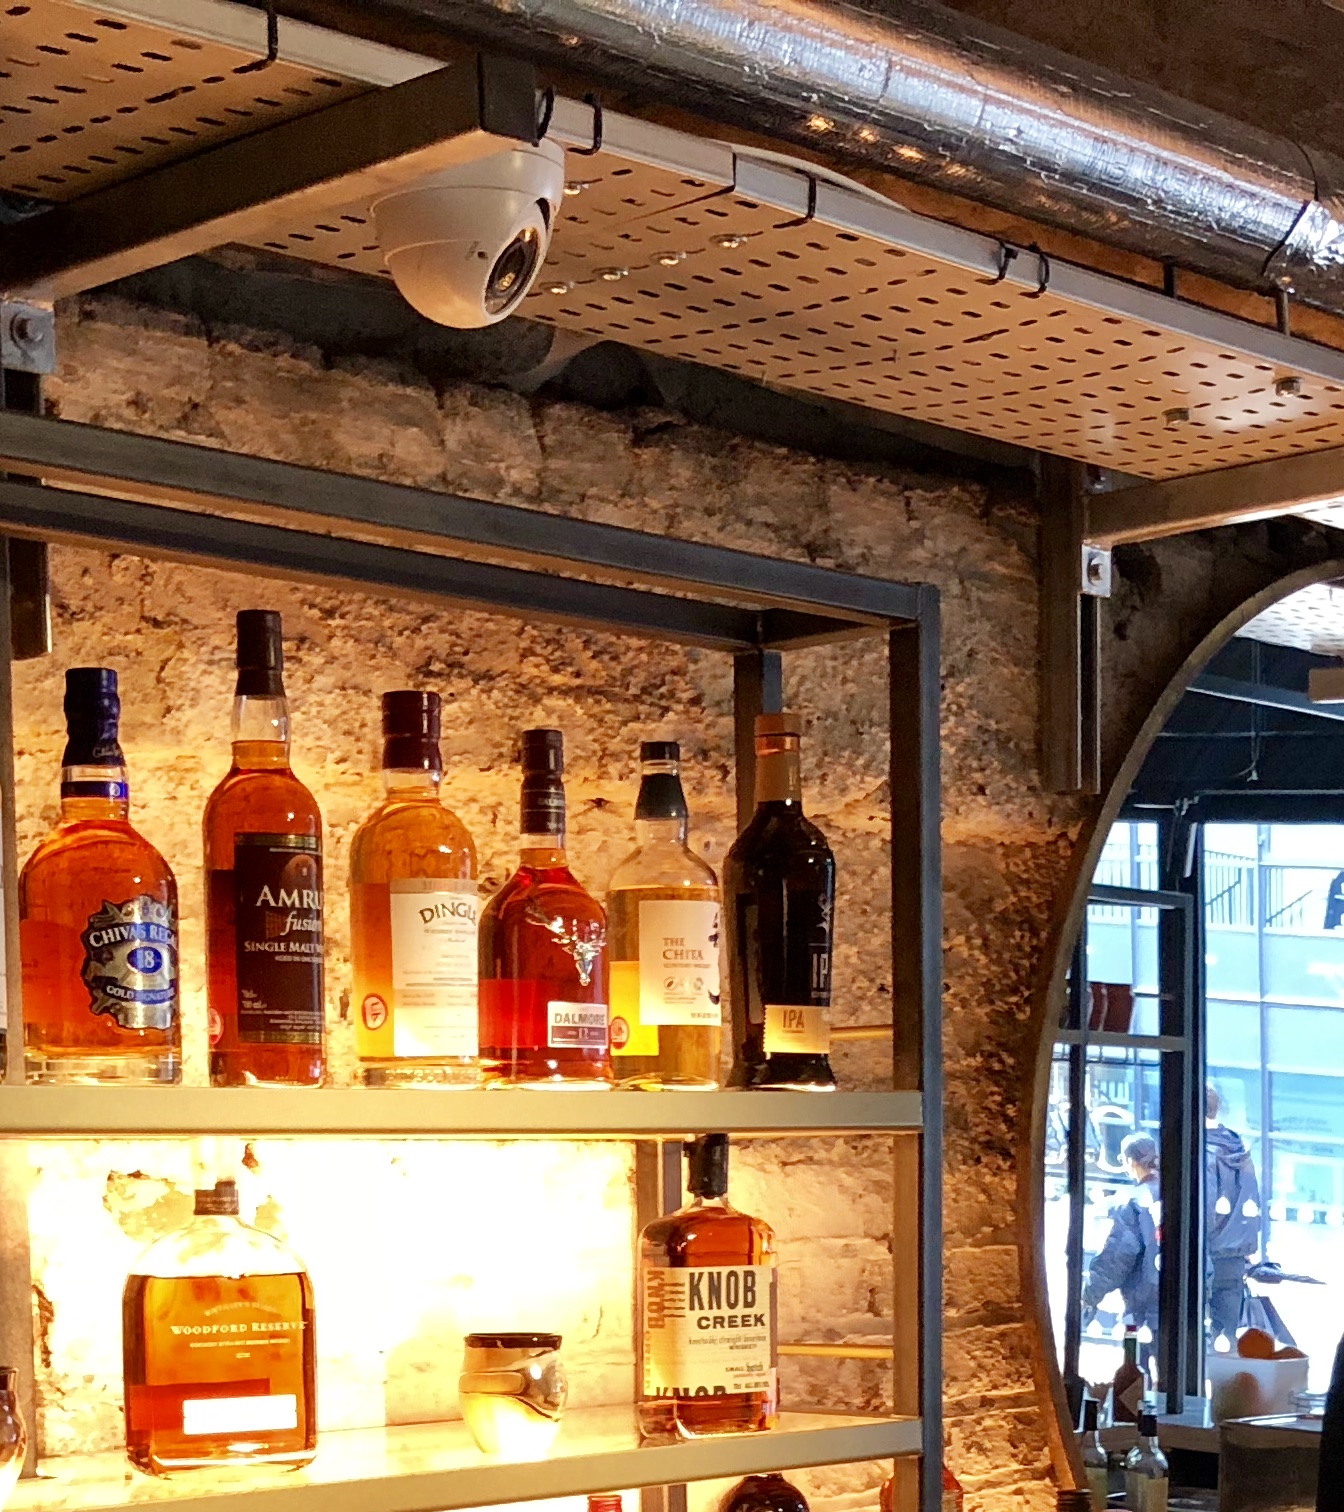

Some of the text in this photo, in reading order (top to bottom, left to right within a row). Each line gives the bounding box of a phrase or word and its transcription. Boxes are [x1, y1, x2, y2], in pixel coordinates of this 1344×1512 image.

[89, 922, 147, 948] CHIVAS
[662, 937, 685, 947] THE
[243, 941, 288, 953] SINGLE
[662, 949, 704, 961] CHITA
[136, 949, 155, 969] 18
[106, 984, 134, 1000] GOLD
[554, 1012, 606, 1026] DALMORE
[782, 1008, 806, 1029] IPA
[688, 1269, 757, 1311] KNOB
[170, 1320, 307, 1336] WOODFORD RESERVE
[696, 1313, 766, 1330] CREEK
